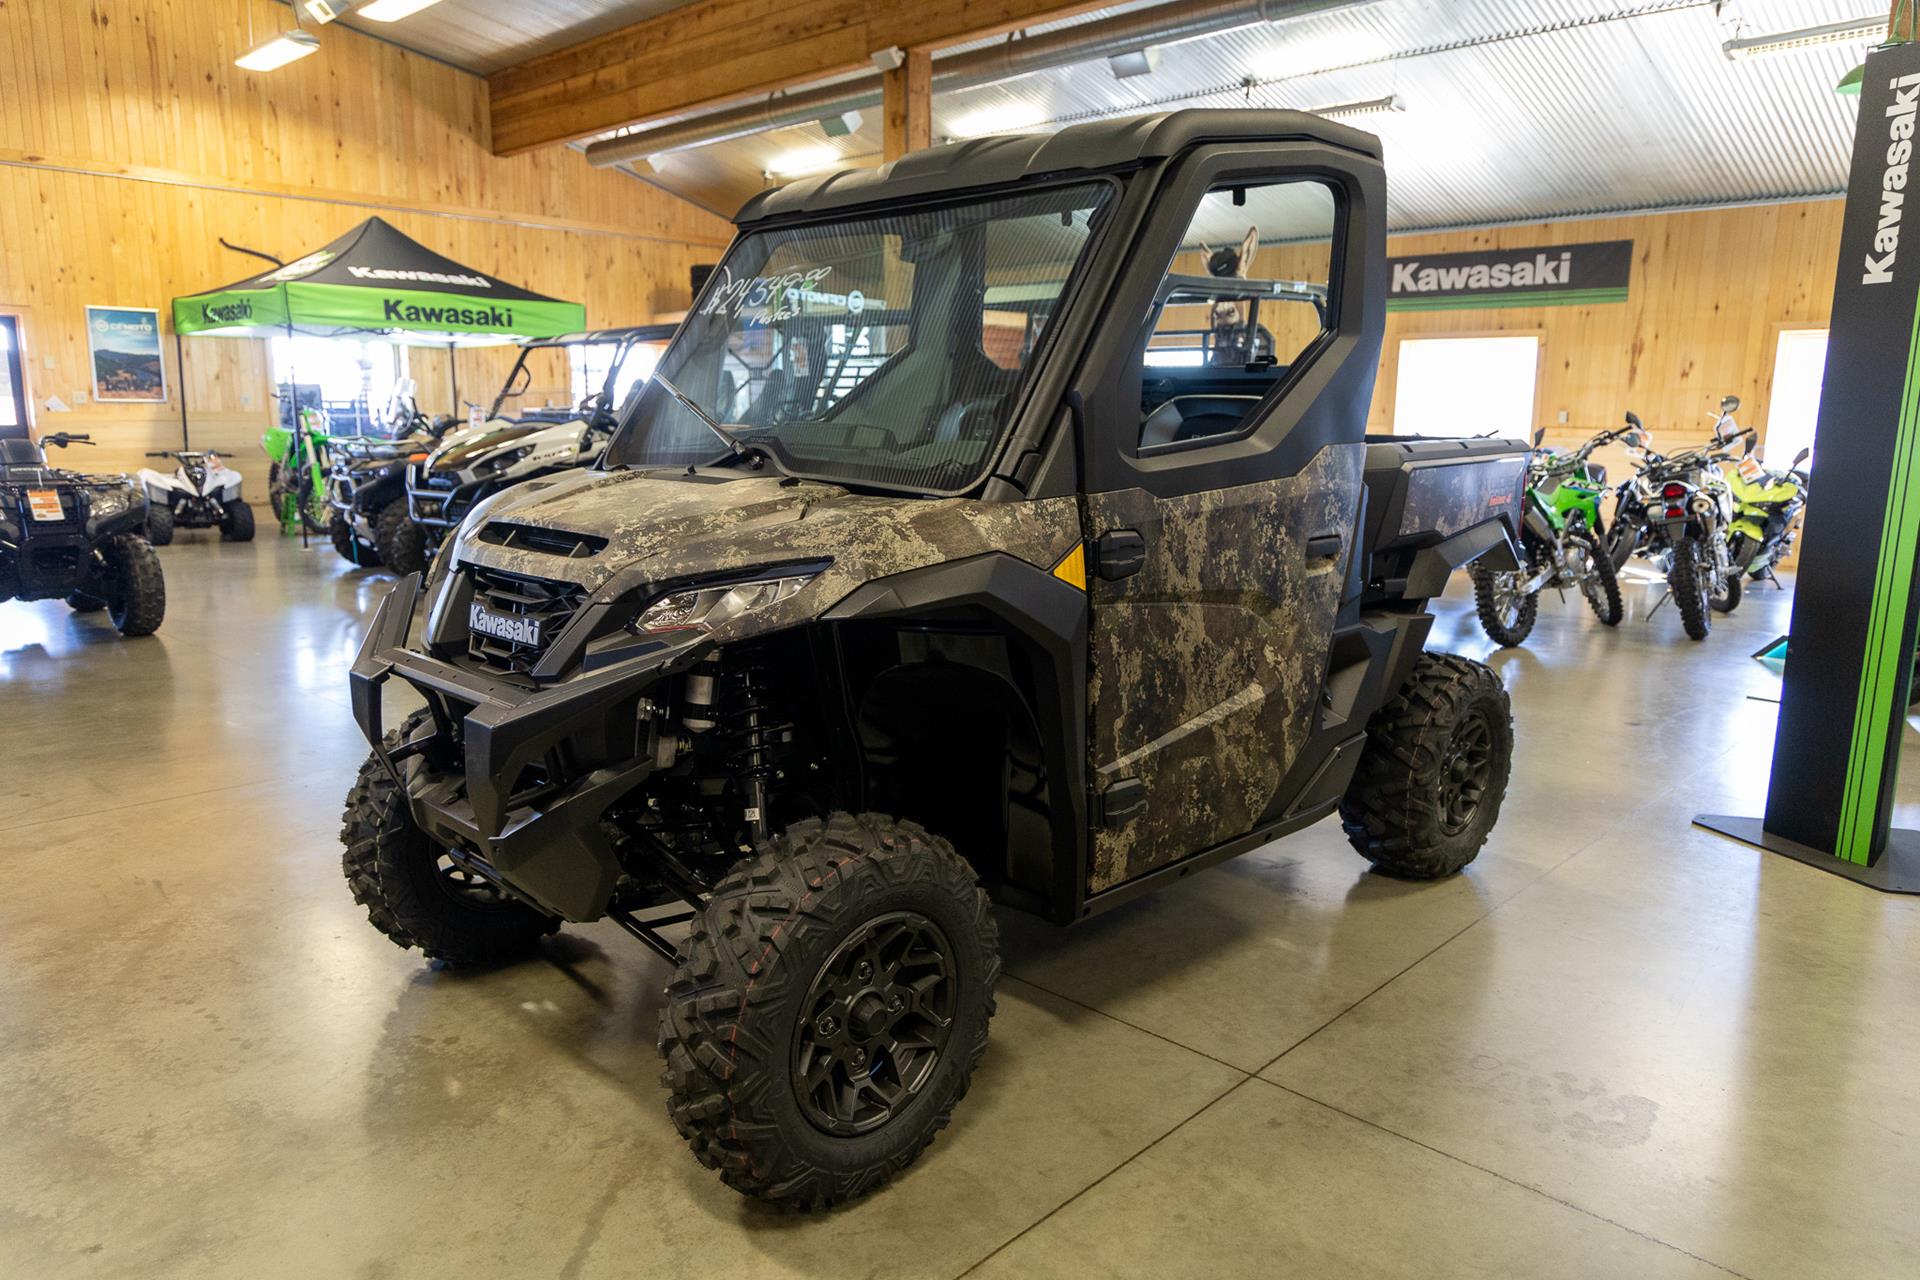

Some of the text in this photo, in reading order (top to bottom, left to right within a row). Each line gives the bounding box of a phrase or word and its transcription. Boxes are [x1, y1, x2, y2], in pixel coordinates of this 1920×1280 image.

[1862, 72, 1920, 285] Kawasaki
[347, 266, 492, 288] Kawasaki
[1391, 252, 1572, 293] Kawasaki
[202, 298, 253, 325] Kawasaki
[383, 299, 513, 327] Kawasaki
[469, 603, 540, 646] Kawasaki
